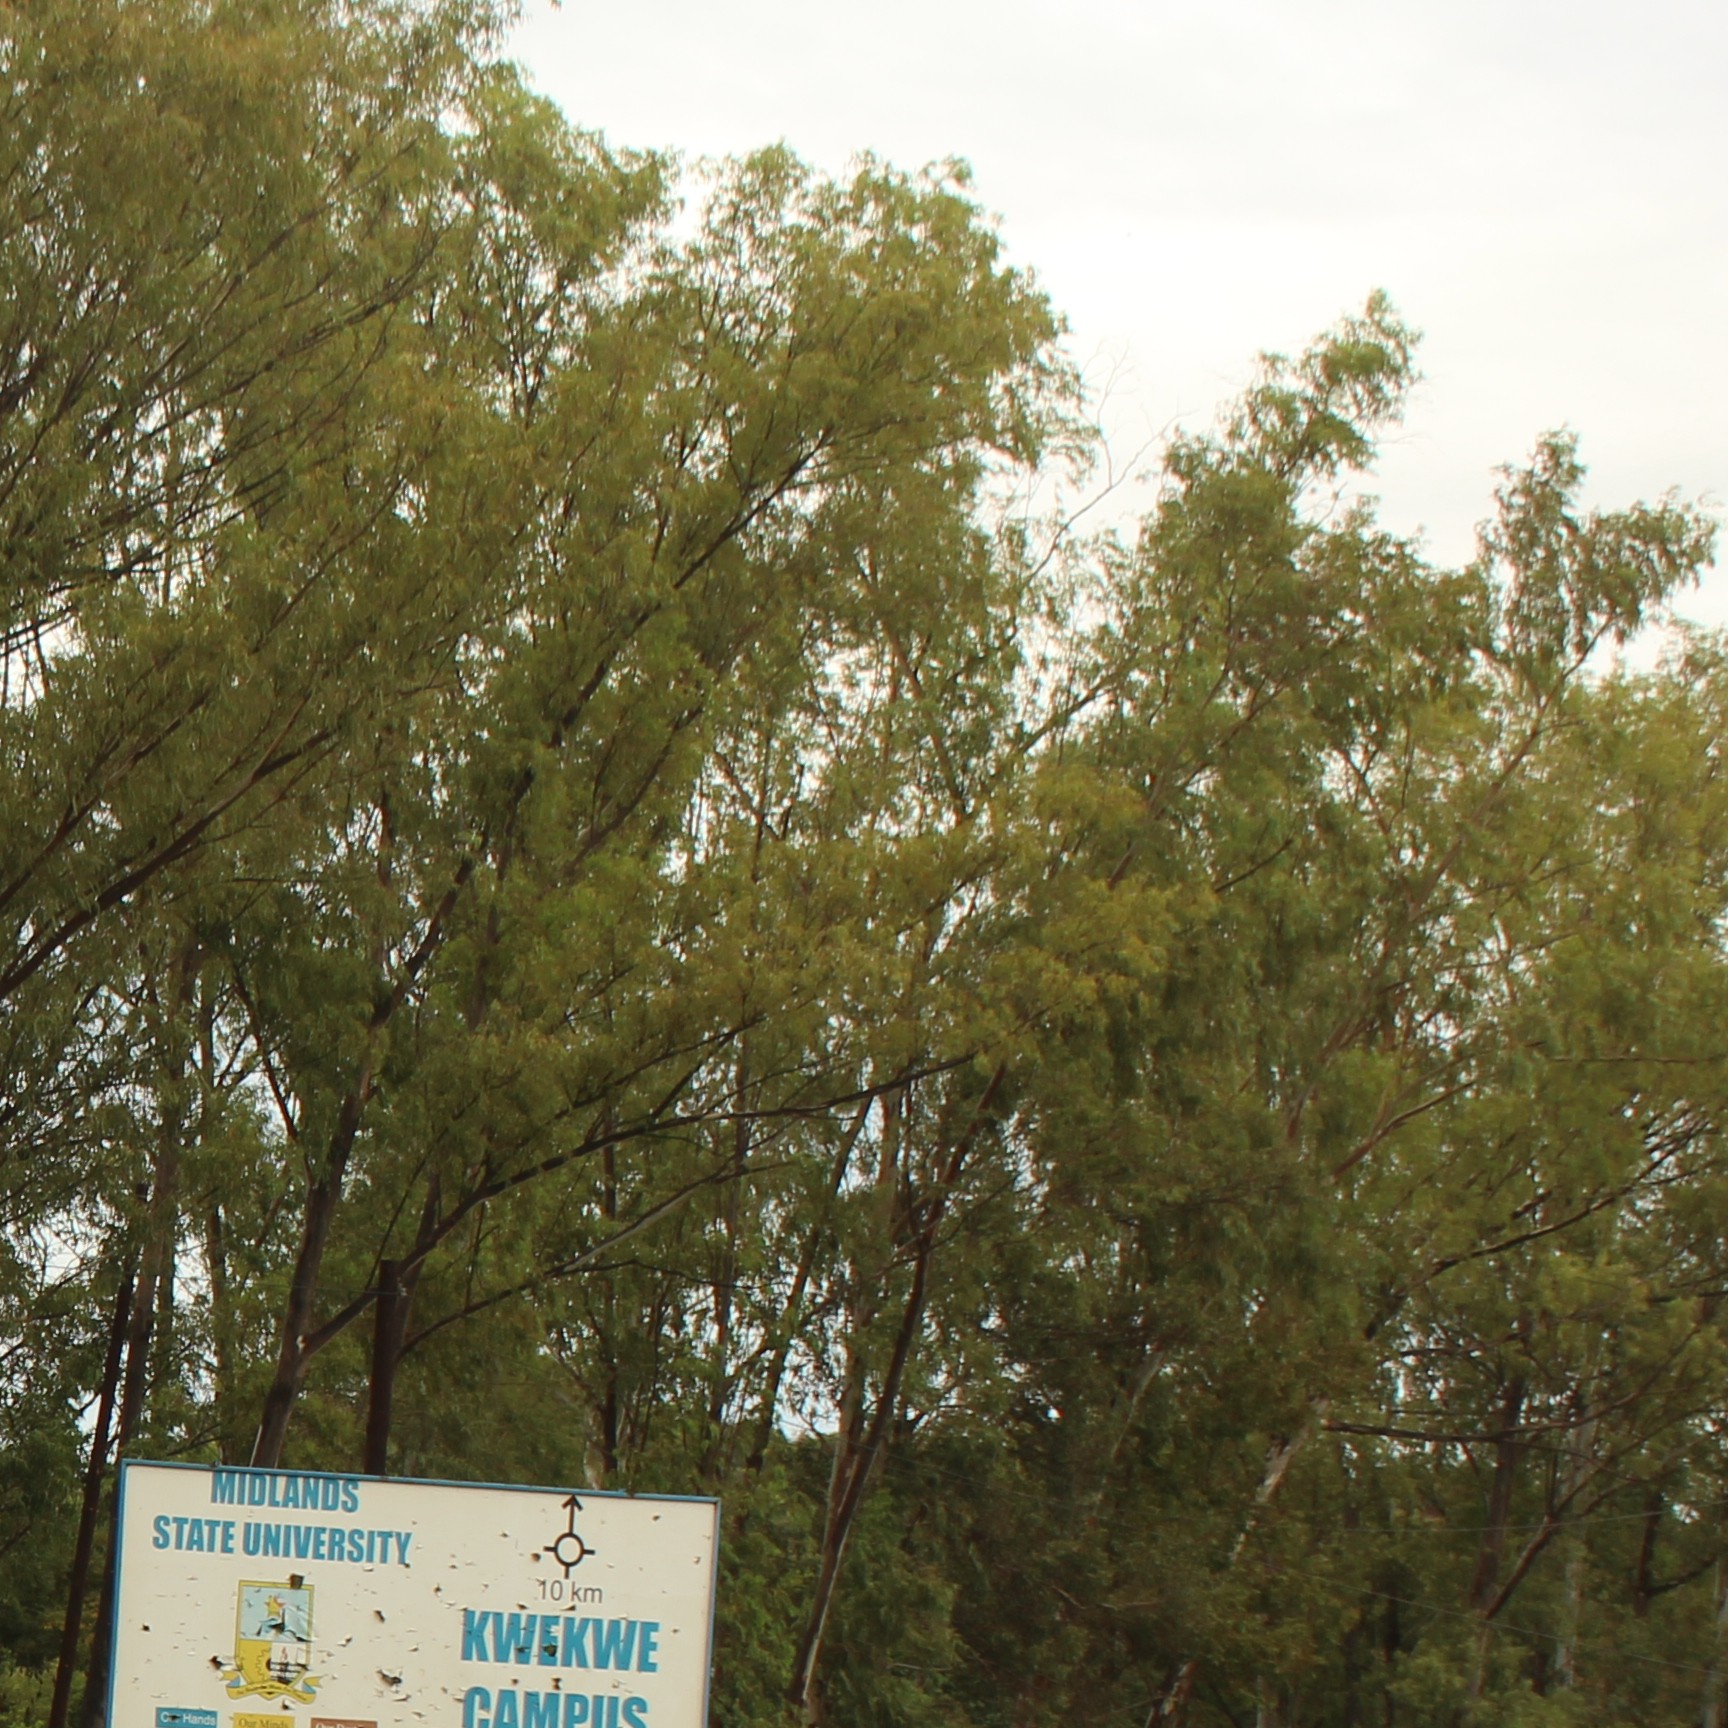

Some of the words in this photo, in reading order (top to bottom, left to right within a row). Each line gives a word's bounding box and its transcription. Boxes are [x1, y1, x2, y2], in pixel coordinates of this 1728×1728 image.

[210, 1471, 359, 1513] MIDLANDS
[152, 1514, 235, 1554] STATE
[243, 1521, 412, 1565] UNIVERSITY
[539, 1579, 563, 1601] 10
[571, 1581, 603, 1604] km
[461, 1609, 660, 1673] KWEKWE
[183, 1713, 216, 1726] Hands
[238, 1717, 257, 1728] Our
